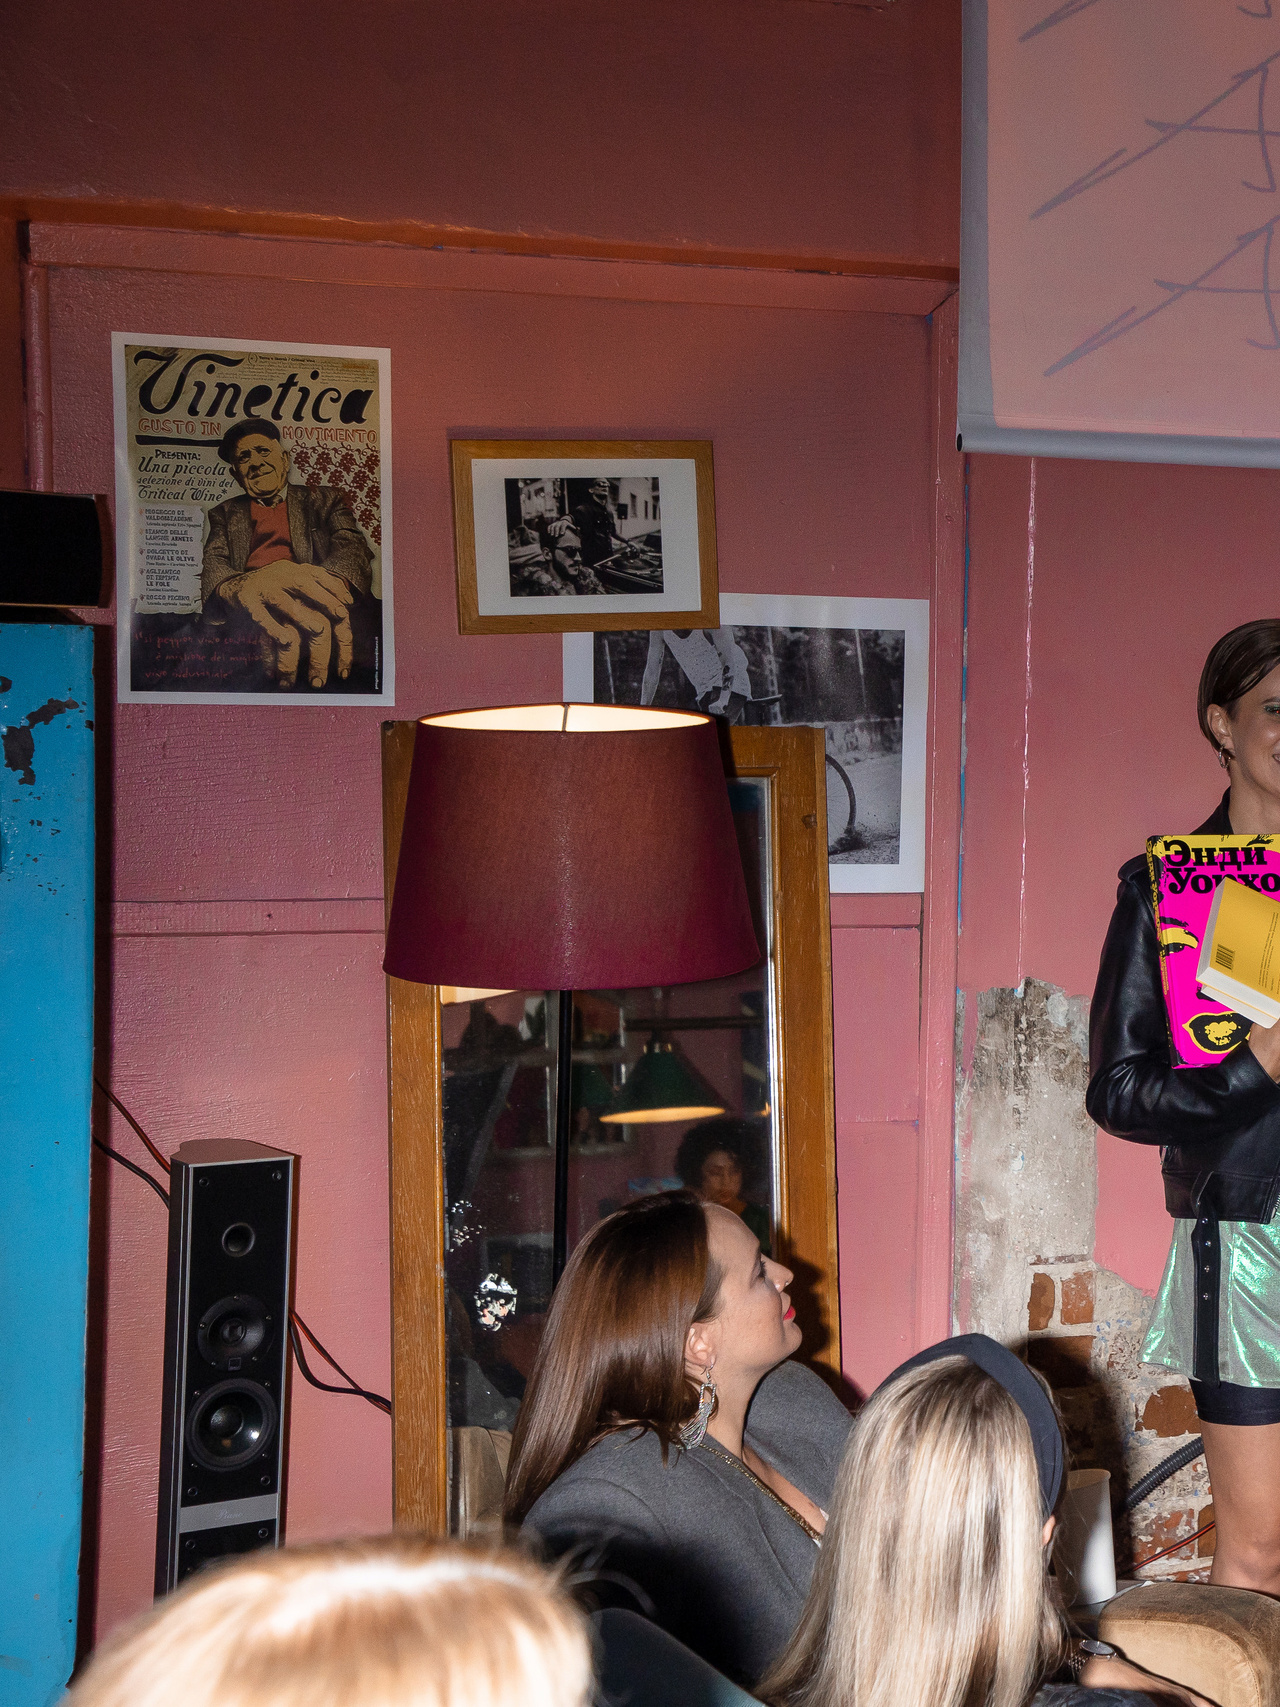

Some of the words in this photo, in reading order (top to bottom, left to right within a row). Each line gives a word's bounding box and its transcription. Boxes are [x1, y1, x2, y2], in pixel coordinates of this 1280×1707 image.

[133, 350, 374, 425] Vinetica
[138, 417, 196, 435] GUSTO
[201, 421, 222, 436] IN
[282, 425, 378, 443] MOVIMENTO
[155, 449, 201, 460] PRESENTA:
[138, 456, 170, 473] Una
[172, 461, 226, 478] piccola
[136, 475, 182, 486] selezione
[184, 477, 196, 487] di
[197, 478, 216, 487] vini
[218, 478, 235, 488] del
[138, 484, 187, 500] Critical
[1163, 840, 1268, 871] Энди
